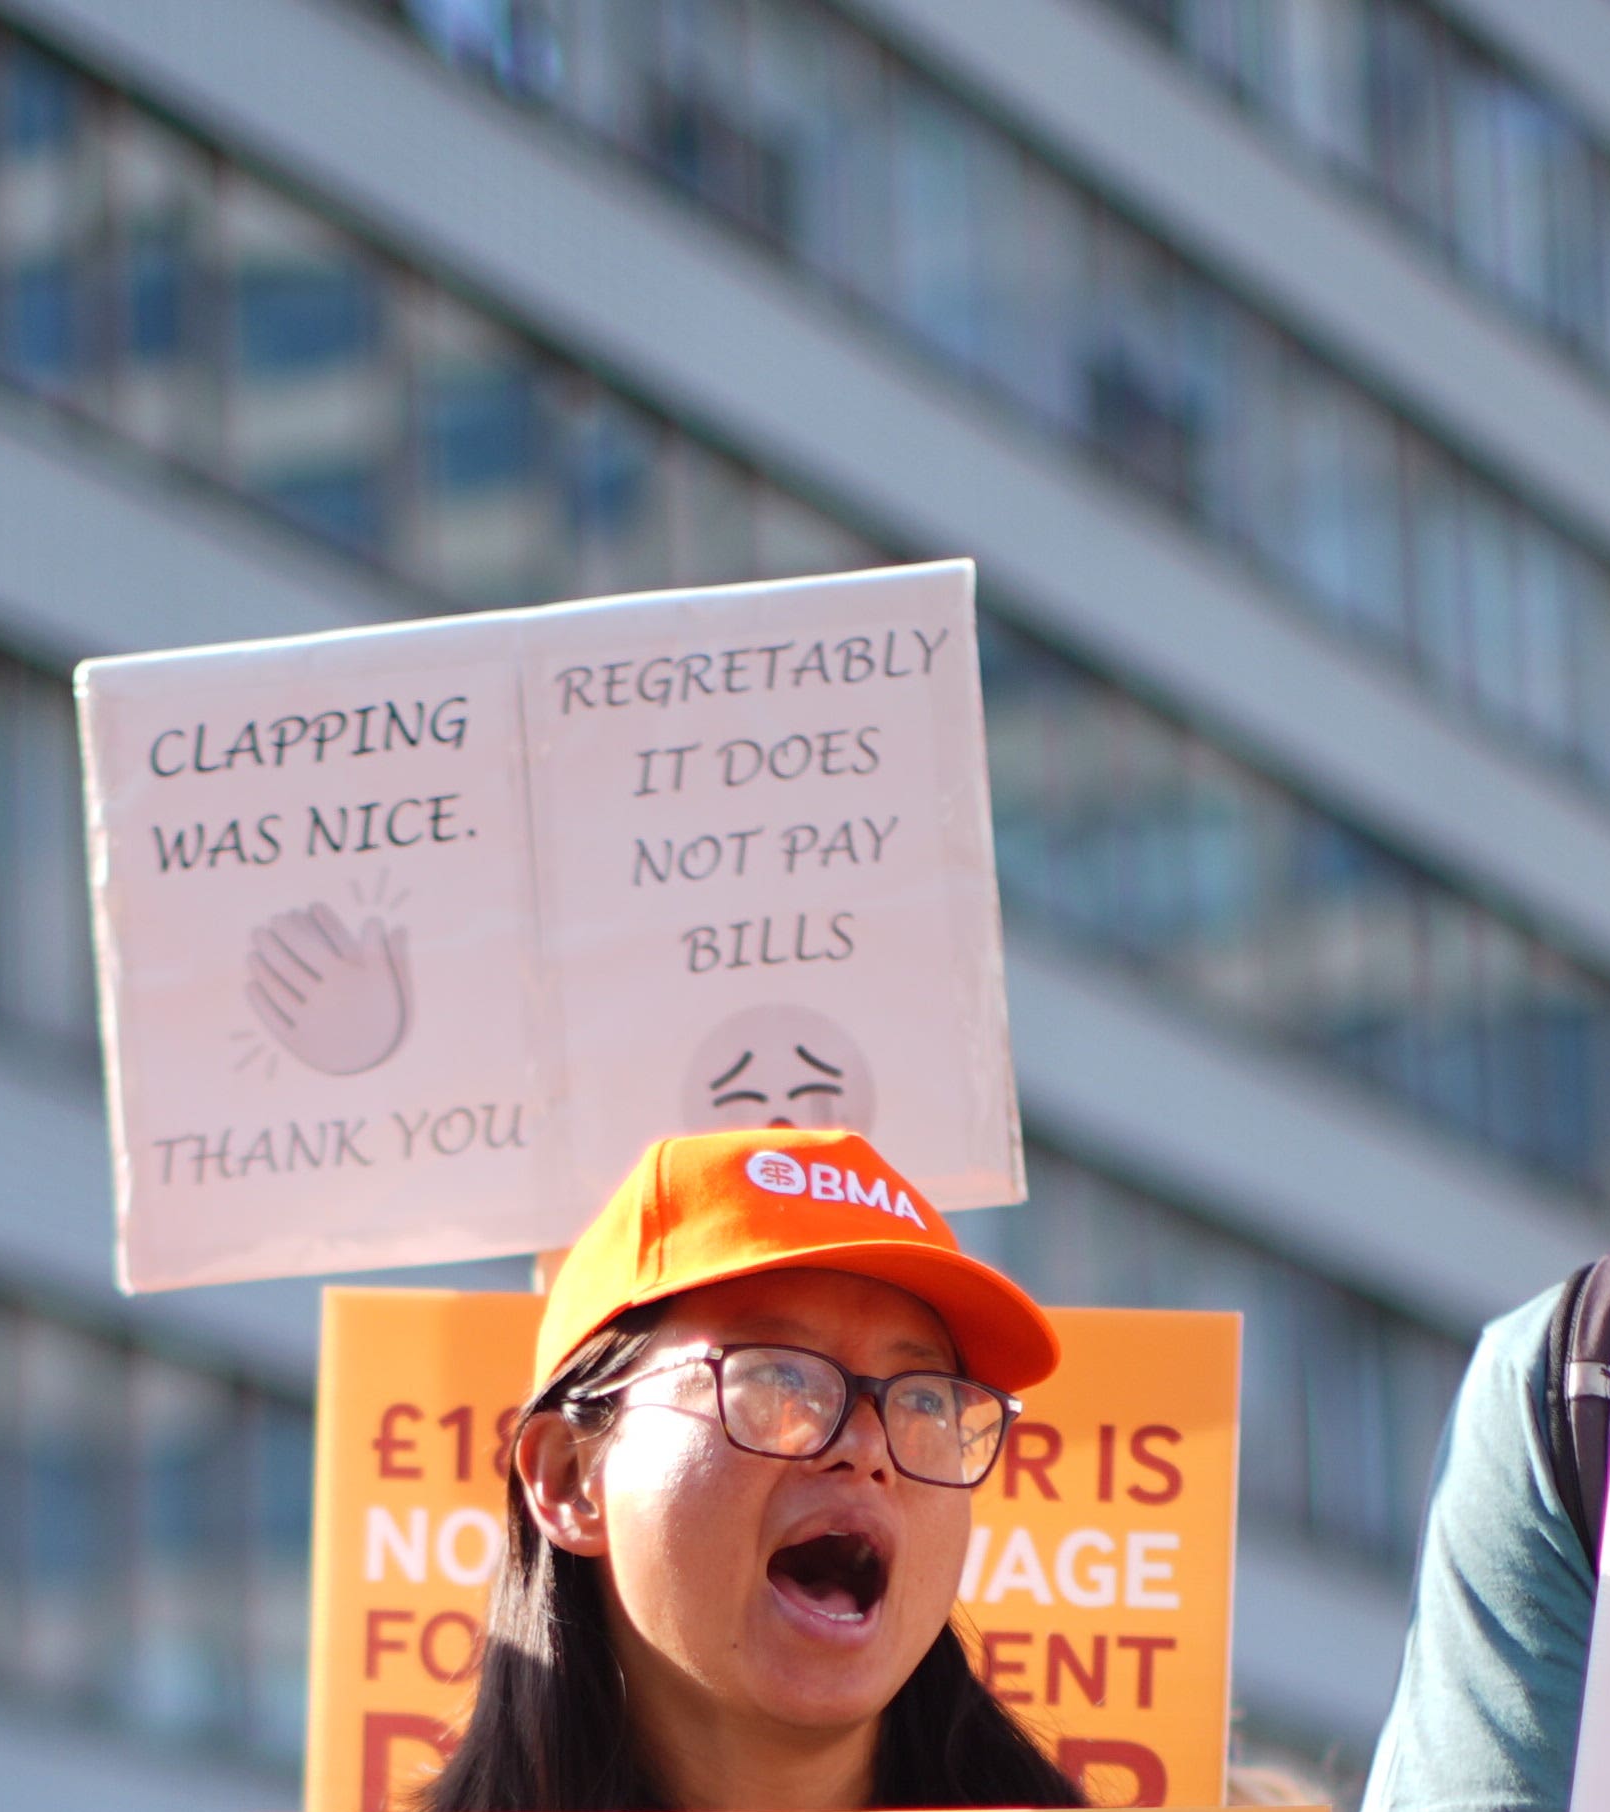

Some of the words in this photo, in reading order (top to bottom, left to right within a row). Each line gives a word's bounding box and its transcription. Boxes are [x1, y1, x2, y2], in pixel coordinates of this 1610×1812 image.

[553, 628, 951, 715] REGRETABLY
[149, 696, 470, 778] CLAPPING
[631, 744, 710, 798] IT
[721, 725, 882, 788] DOES
[152, 813, 283, 873] WAS
[306, 793, 477, 856] NICE.
[631, 828, 763, 887] NOT
[782, 815, 900, 874] PAY
[681, 911, 856, 974] BILLS
[153, 1119, 374, 1188] THANK
[392, 1101, 527, 1157] YOU
[810, 1163, 927, 1231] BMA
[1097, 1423, 1185, 1507] IS
[363, 1505, 507, 1587] NO
[364, 1609, 489, 1698] FO
